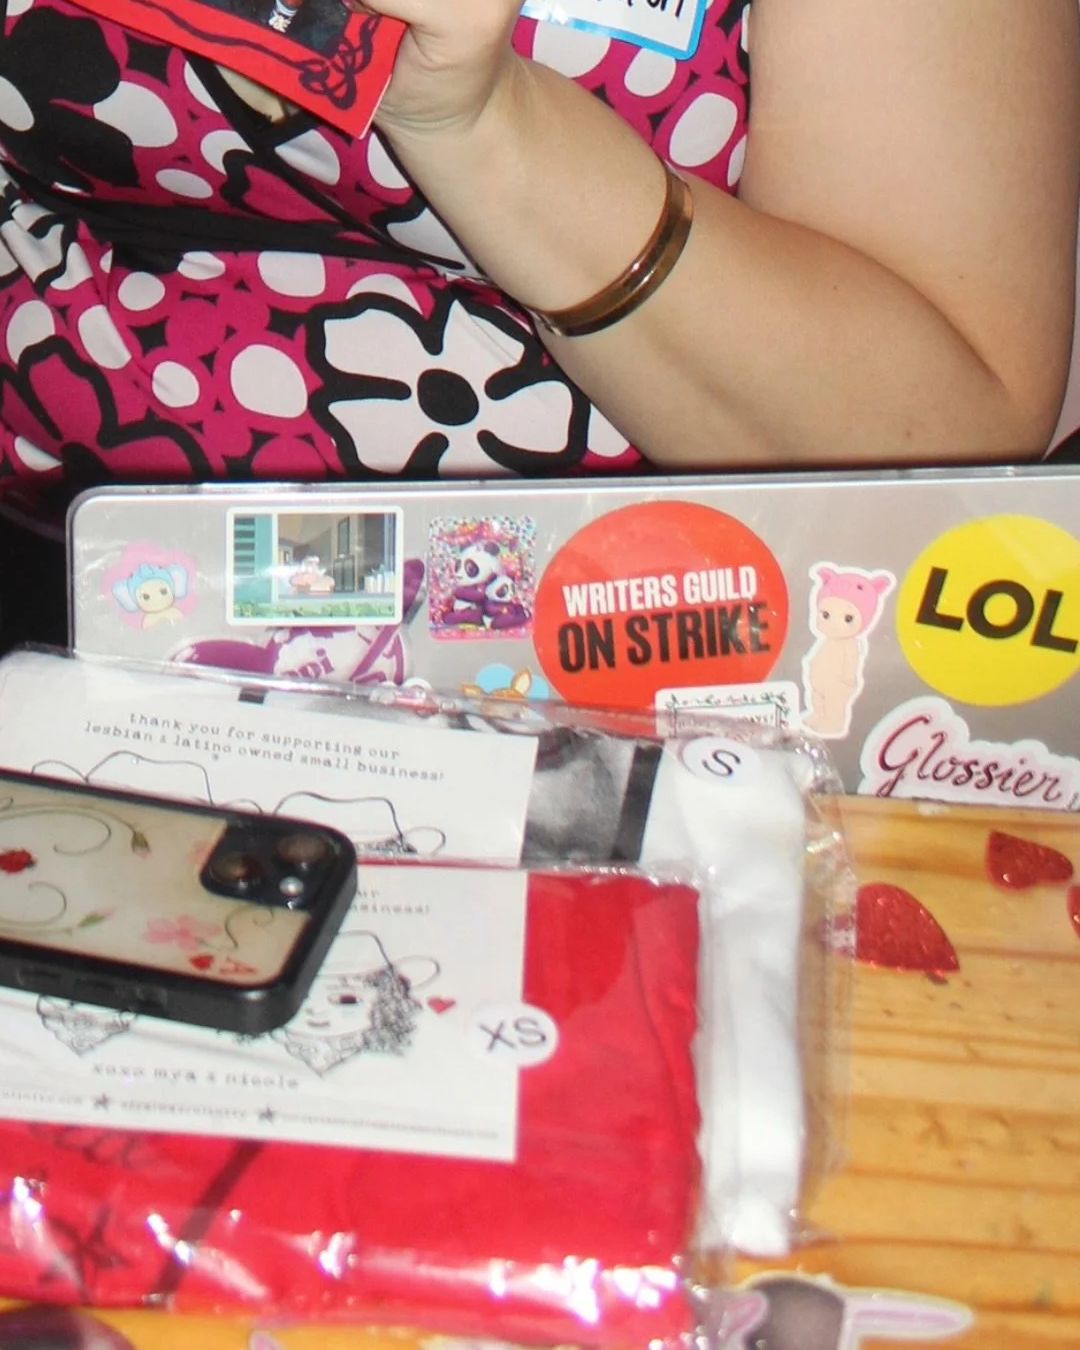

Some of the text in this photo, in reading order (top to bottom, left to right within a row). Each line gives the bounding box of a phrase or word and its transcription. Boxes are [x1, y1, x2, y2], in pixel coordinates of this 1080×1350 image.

[562, 565, 757, 618] WRITERS GUILD
[916, 565, 1079, 654] LOL
[557, 602, 772, 673] ON STRIKE
[84, 720, 154, 744] lesbian
[237, 745, 294, 763] owned
[299, 753, 350, 771] small
[129, 712, 401, 761] thank you for supporting our
[876, 713, 1062, 802] Glossier
[701, 749, 742, 778] S
[477, 1015, 547, 1052] XS
